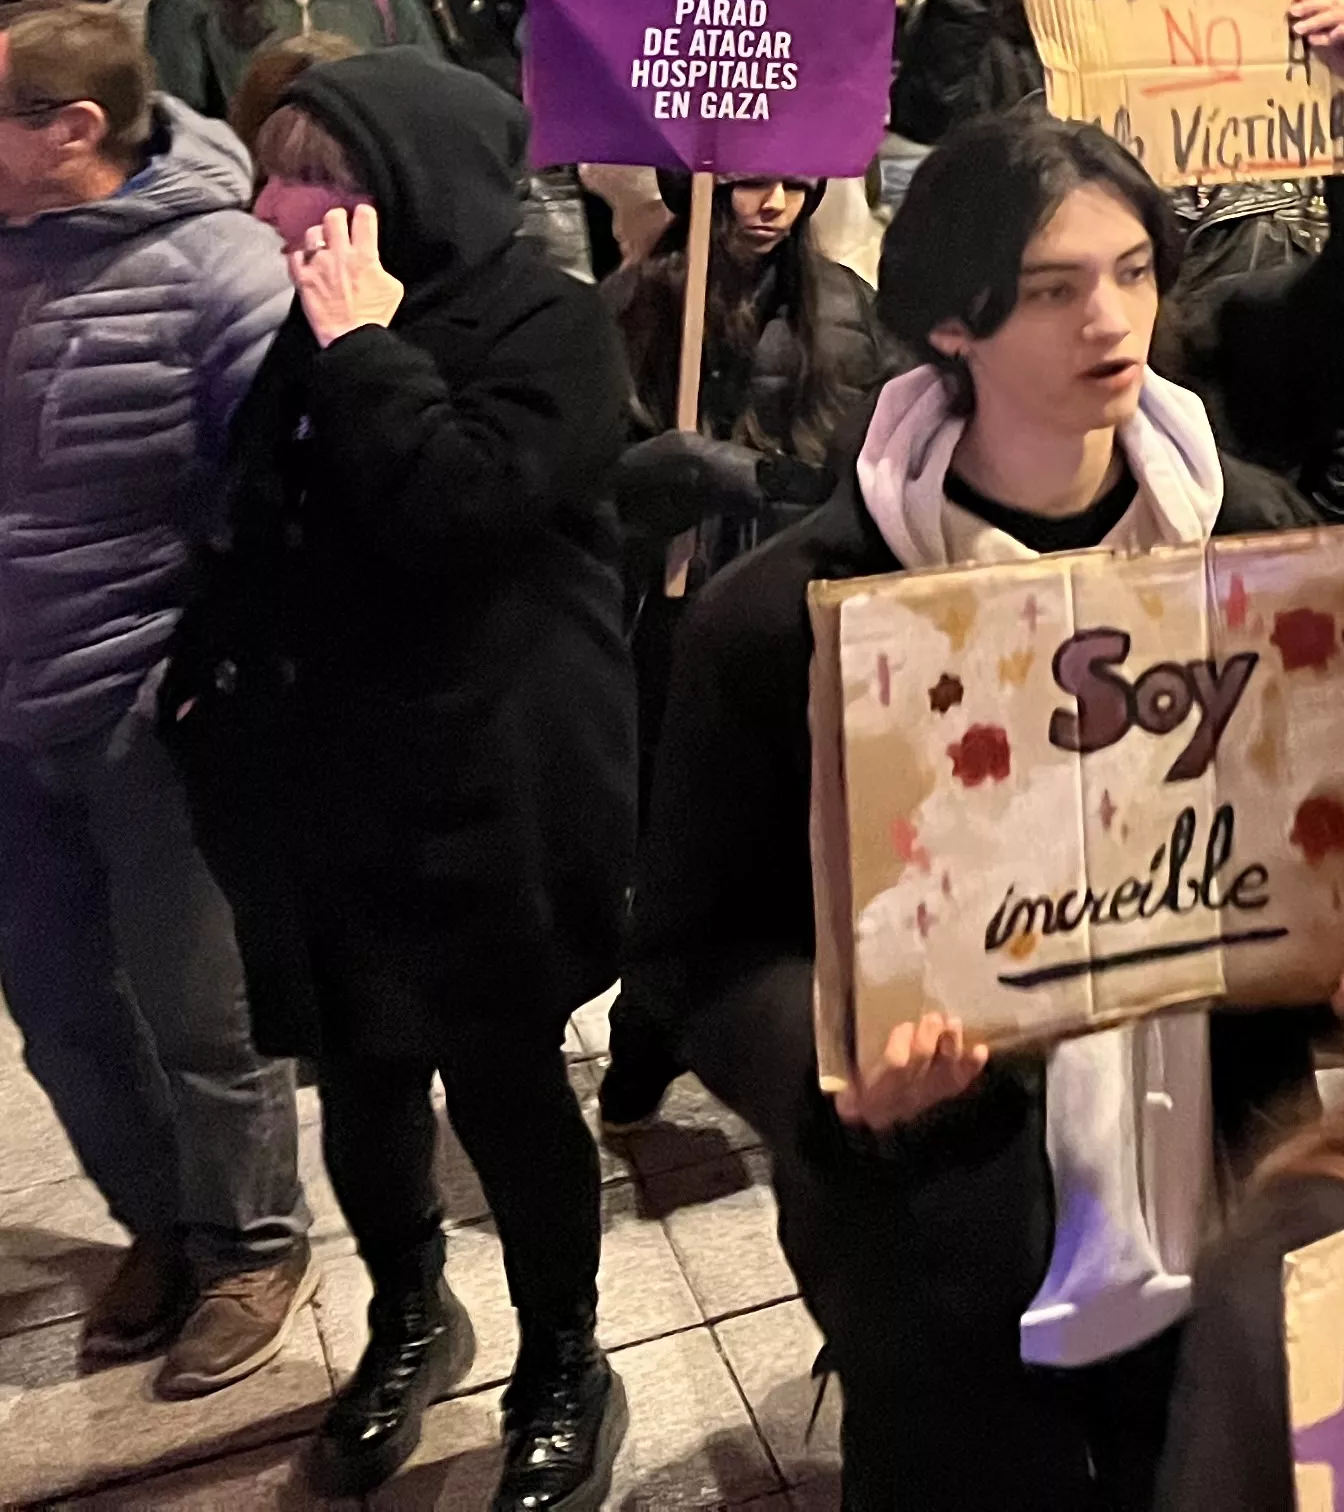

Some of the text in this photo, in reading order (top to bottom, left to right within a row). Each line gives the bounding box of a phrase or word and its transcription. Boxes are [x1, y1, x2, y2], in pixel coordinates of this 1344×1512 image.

[643, 27, 792, 59] DE ATACAR
[631, 59, 799, 91] HOSPITALES
[653, 90, 770, 121] EN GAZA
[1048, 626, 1260, 783] Soy
